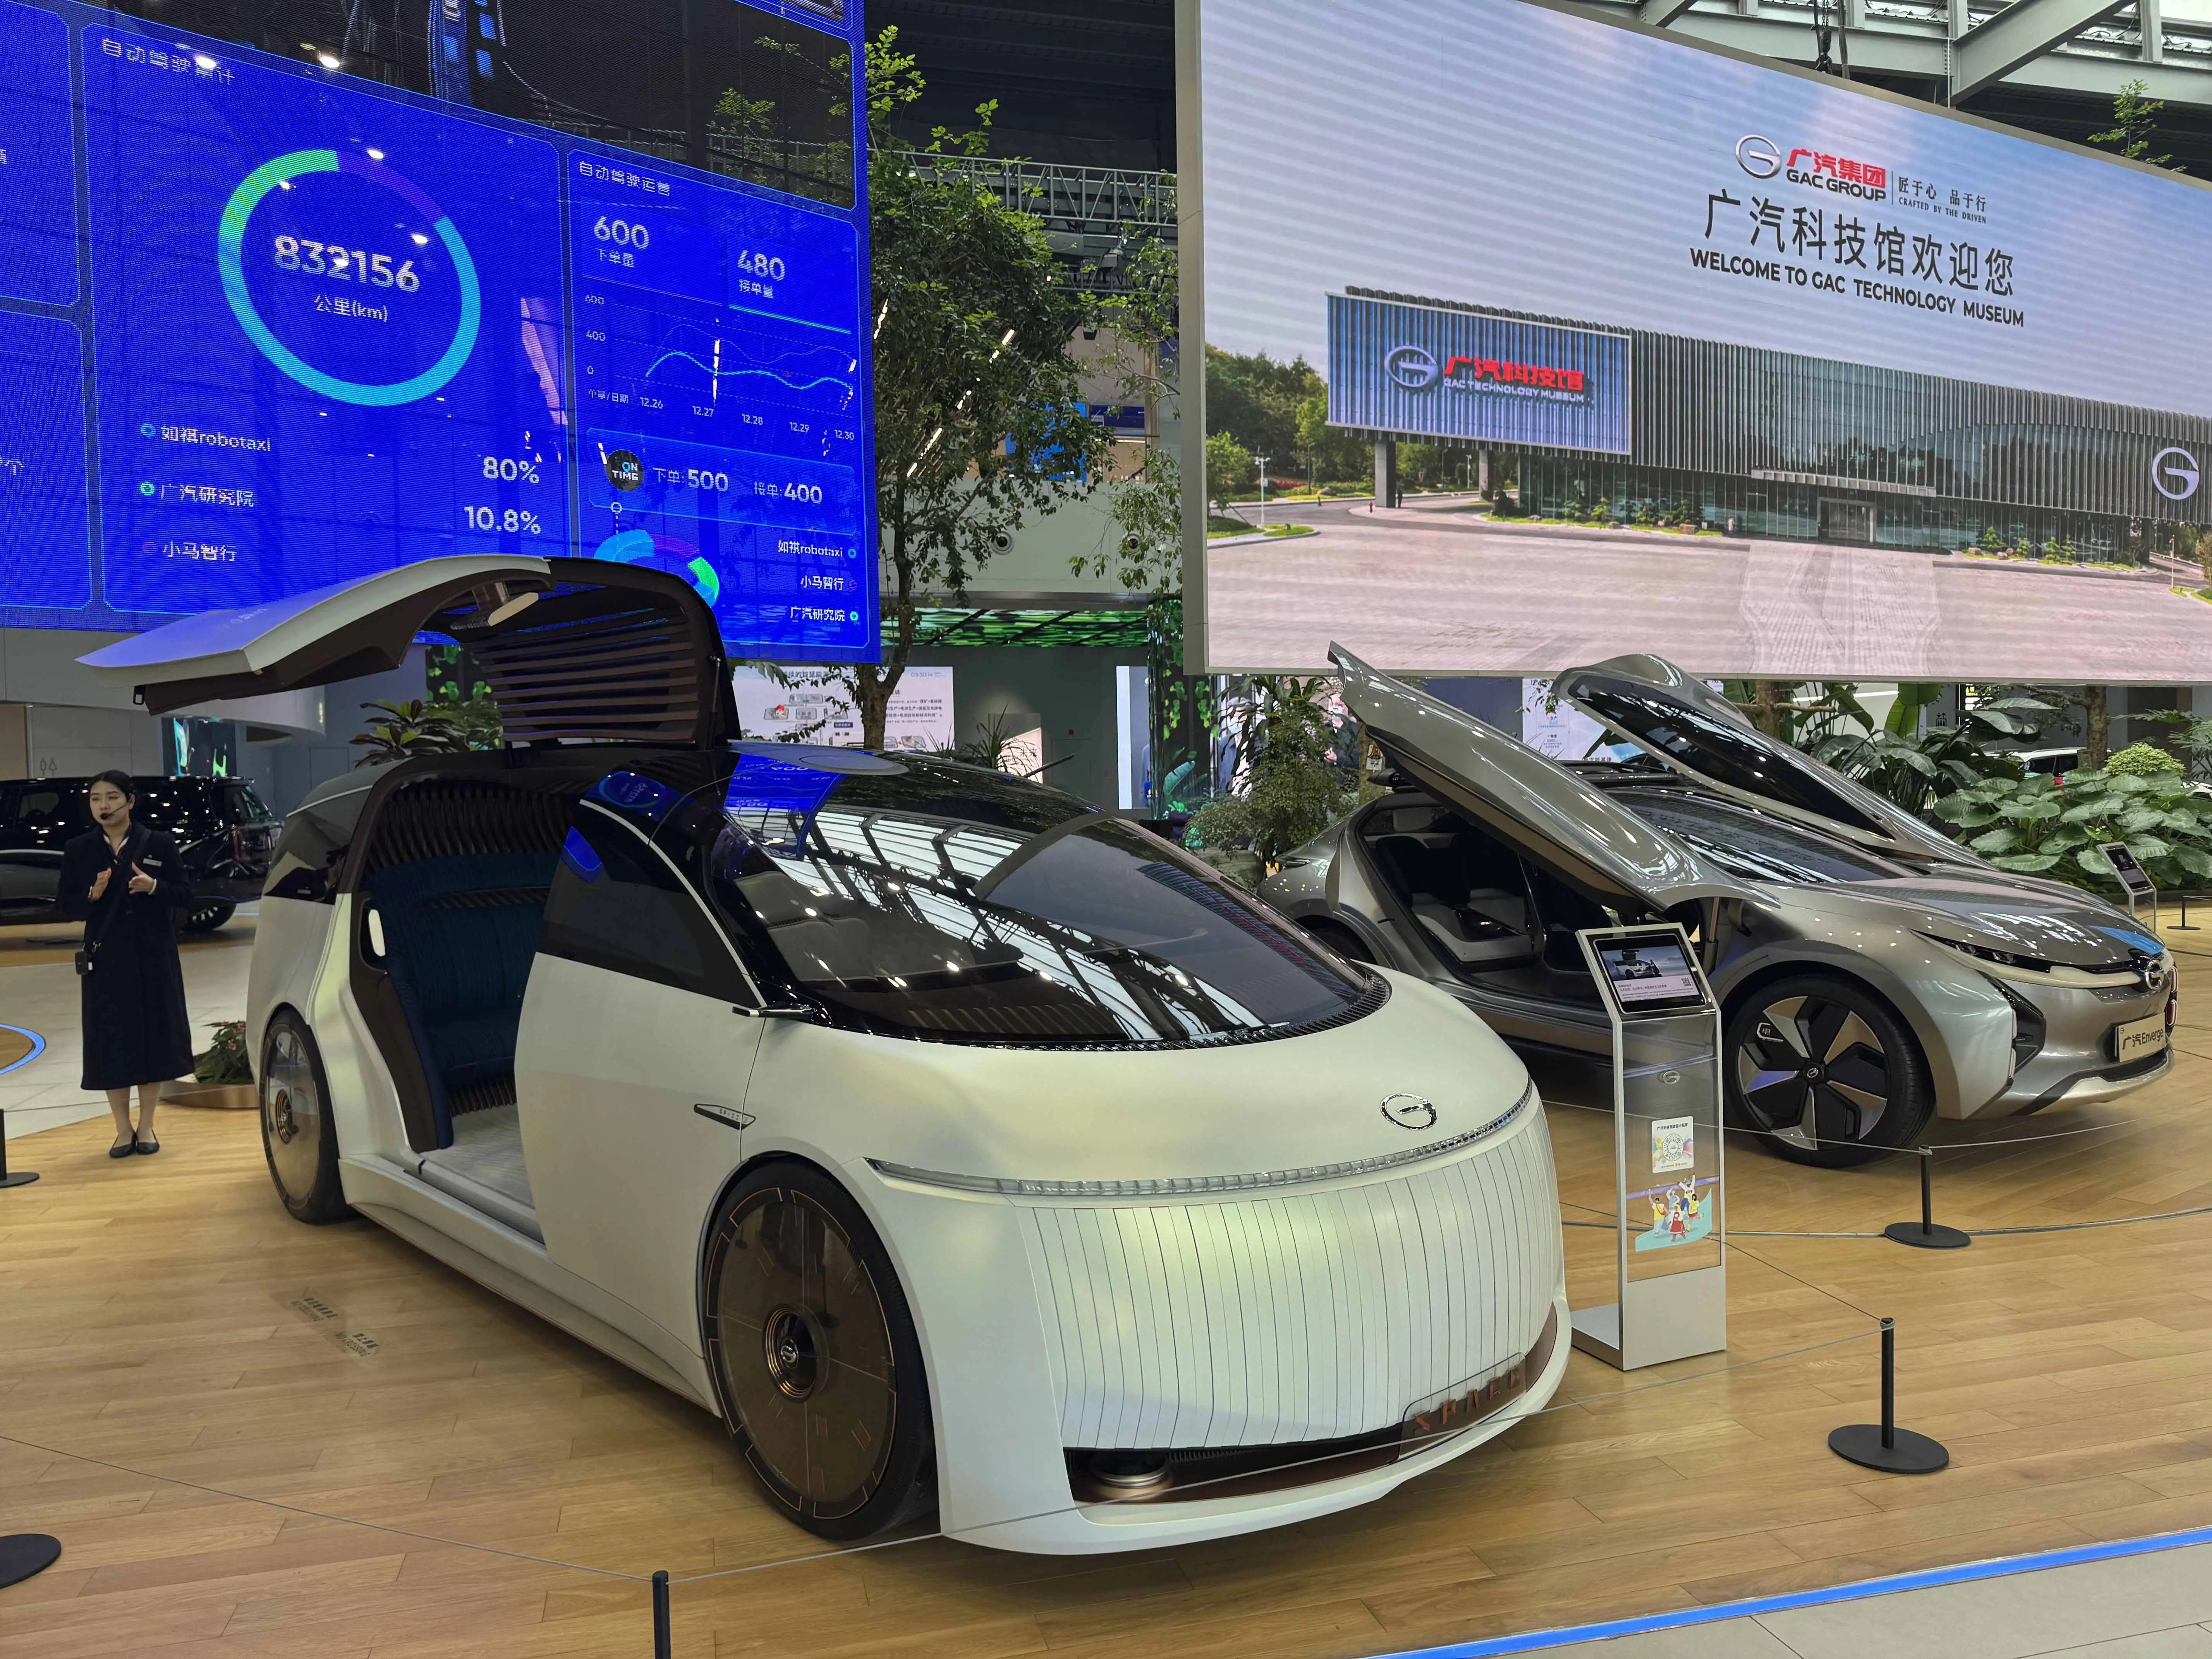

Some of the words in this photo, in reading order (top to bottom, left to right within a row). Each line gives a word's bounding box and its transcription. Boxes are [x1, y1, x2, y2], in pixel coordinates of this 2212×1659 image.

[580, 161, 670, 196] 自动驾驶运营
[1786, 148, 1886, 189] 广汽集团
[1786, 169, 1823, 189] GAC
[1826, 177, 1886, 201] GROUP
[1898, 177, 1937, 200] 匠于心
[1949, 189, 1987, 213] 品于行
[1898, 197, 1929, 211] CRAFTED
[1933, 205, 1942, 215] BY
[1945, 207, 1958, 218] THE
[1961, 211, 1987, 225] DRIVEN
[594, 216, 649, 250] 600
[1704, 188, 2014, 296] 广汽科技馆欢迎您
[274, 235, 421, 293] 832156
[595, 248, 635, 268] 下单量
[737, 250, 785, 282] 480
[585, 295, 605, 306] 600
[738, 279, 775, 299] 接单量
[1690, 247, 1781, 283] WELCOME
[1784, 264, 1807, 286] TO
[1812, 270, 1846, 294] GAC
[1853, 278, 1956, 314] TECHNOLOGY
[1963, 299, 2025, 328] MUSEUM
[314, 293, 388, 322] 公里(km)
[586, 331, 606, 342] 400
[1443, 355, 1583, 391] 广汽科技馆
[1467, 379, 1539, 397] TECHNOLOGY
[1540, 390, 1584, 403] MUSEUM
[640, 397, 663, 409] 12.26
[692, 405, 714, 417] 12.27
[742, 414, 764, 426] 12.28
[789, 421, 810, 433] 12.29
[833, 429, 855, 441] 12.30
[483, 456, 540, 484] 80%
[612, 469, 638, 481] TIME
[160, 484, 255, 508] 广汽研究院
[464, 505, 541, 535] 10.8%
[162, 541, 237, 562] 小马智行
[778, 539, 843, 558] 如祺robotaxi
[800, 576, 844, 591] 小马智行
[790, 606, 845, 622] 广汽研究院
